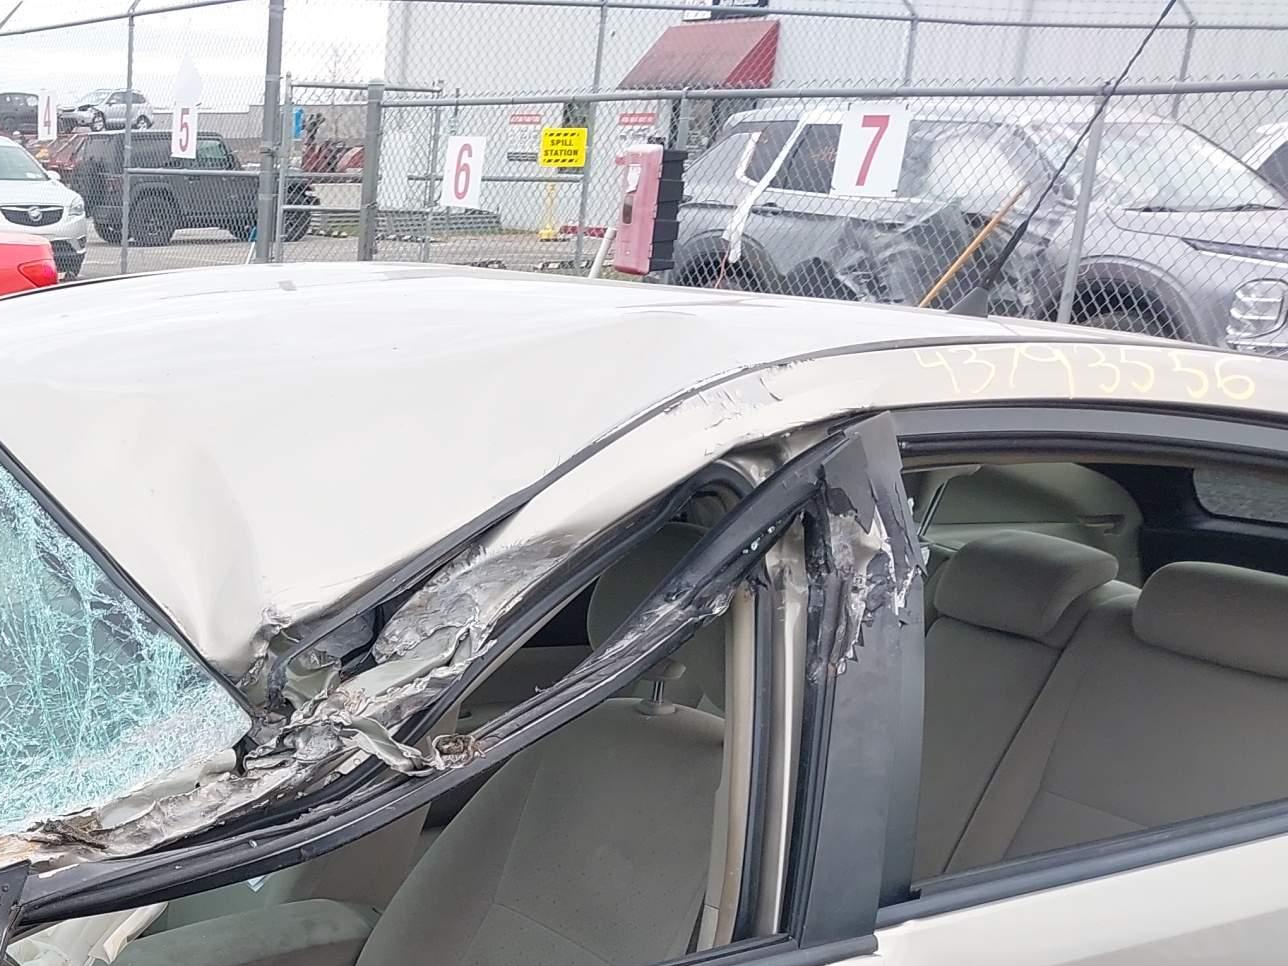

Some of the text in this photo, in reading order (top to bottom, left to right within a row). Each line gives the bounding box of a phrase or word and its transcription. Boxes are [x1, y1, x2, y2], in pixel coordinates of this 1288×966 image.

[43, 95, 52, 135] 4
[179, 108, 190, 152] 5
[543, 149, 579, 157] STATION
[550, 139, 574, 147] SPILL
[855, 115, 890, 186] 7
[454, 143, 472, 200] 6
[914, 346, 1261, 400] 43793556
